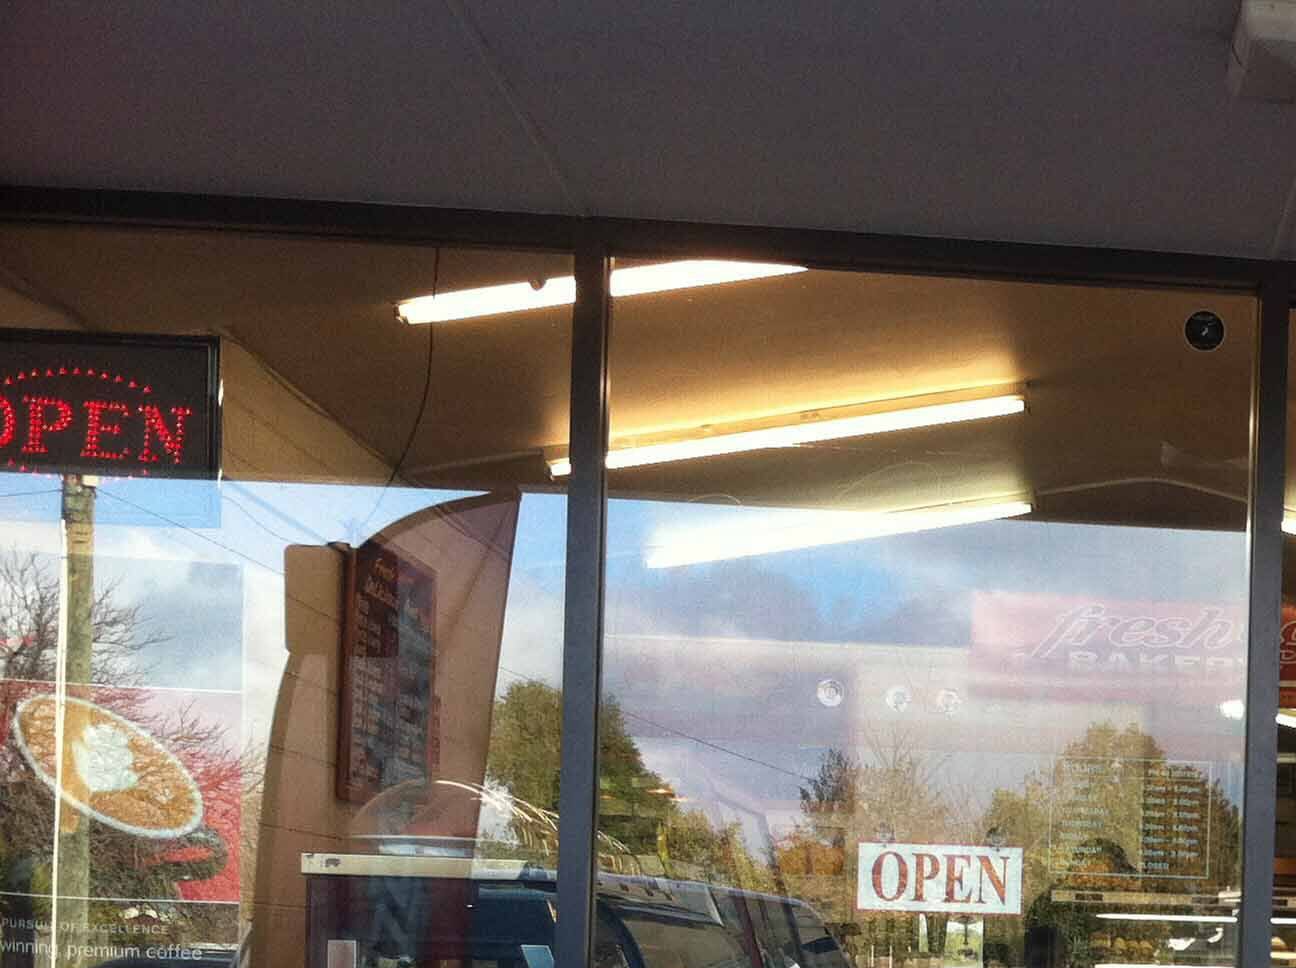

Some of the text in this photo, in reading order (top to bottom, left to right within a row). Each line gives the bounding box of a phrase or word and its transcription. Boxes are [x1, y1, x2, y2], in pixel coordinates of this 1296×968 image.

[0, 394, 192, 464] PEN
[1033, 603, 1233, 658] fresh
[1070, 651, 1246, 673] BAKER
[871, 851, 1011, 906] OPEN
[82, 923, 169, 935] EXCELLENCE
[67, 942, 141, 962] premium
[146, 943, 203, 961] coffee
